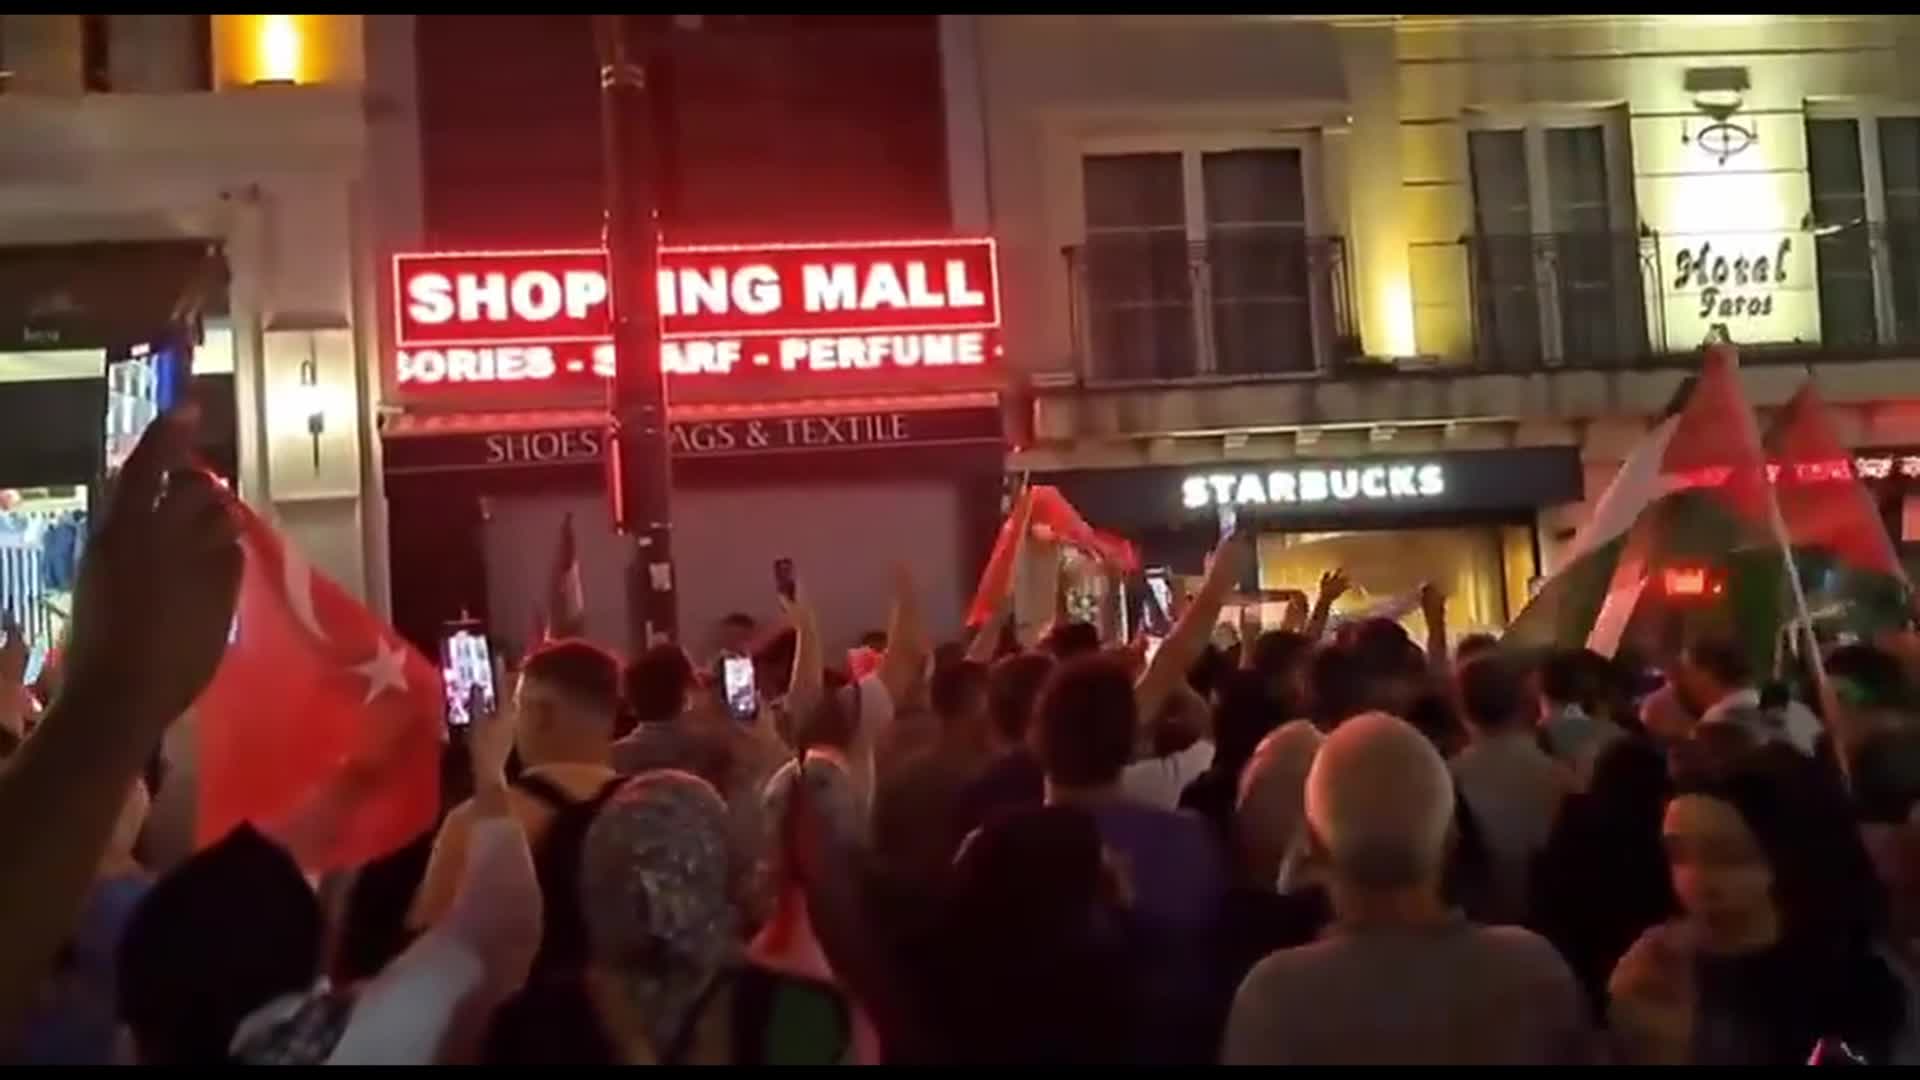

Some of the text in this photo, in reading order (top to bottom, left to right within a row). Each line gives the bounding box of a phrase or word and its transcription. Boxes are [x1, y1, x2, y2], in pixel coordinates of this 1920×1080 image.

[1674, 237, 1791, 289] Hotel
[407, 259, 985, 323] SHOPING MALL
[592, 339, 741, 378] SARF
[779, 333, 985, 371] PERFUME
[486, 413, 909, 464] SHOES AGS & TEXTILE
[1182, 464, 1444, 508] STARBUCKS
